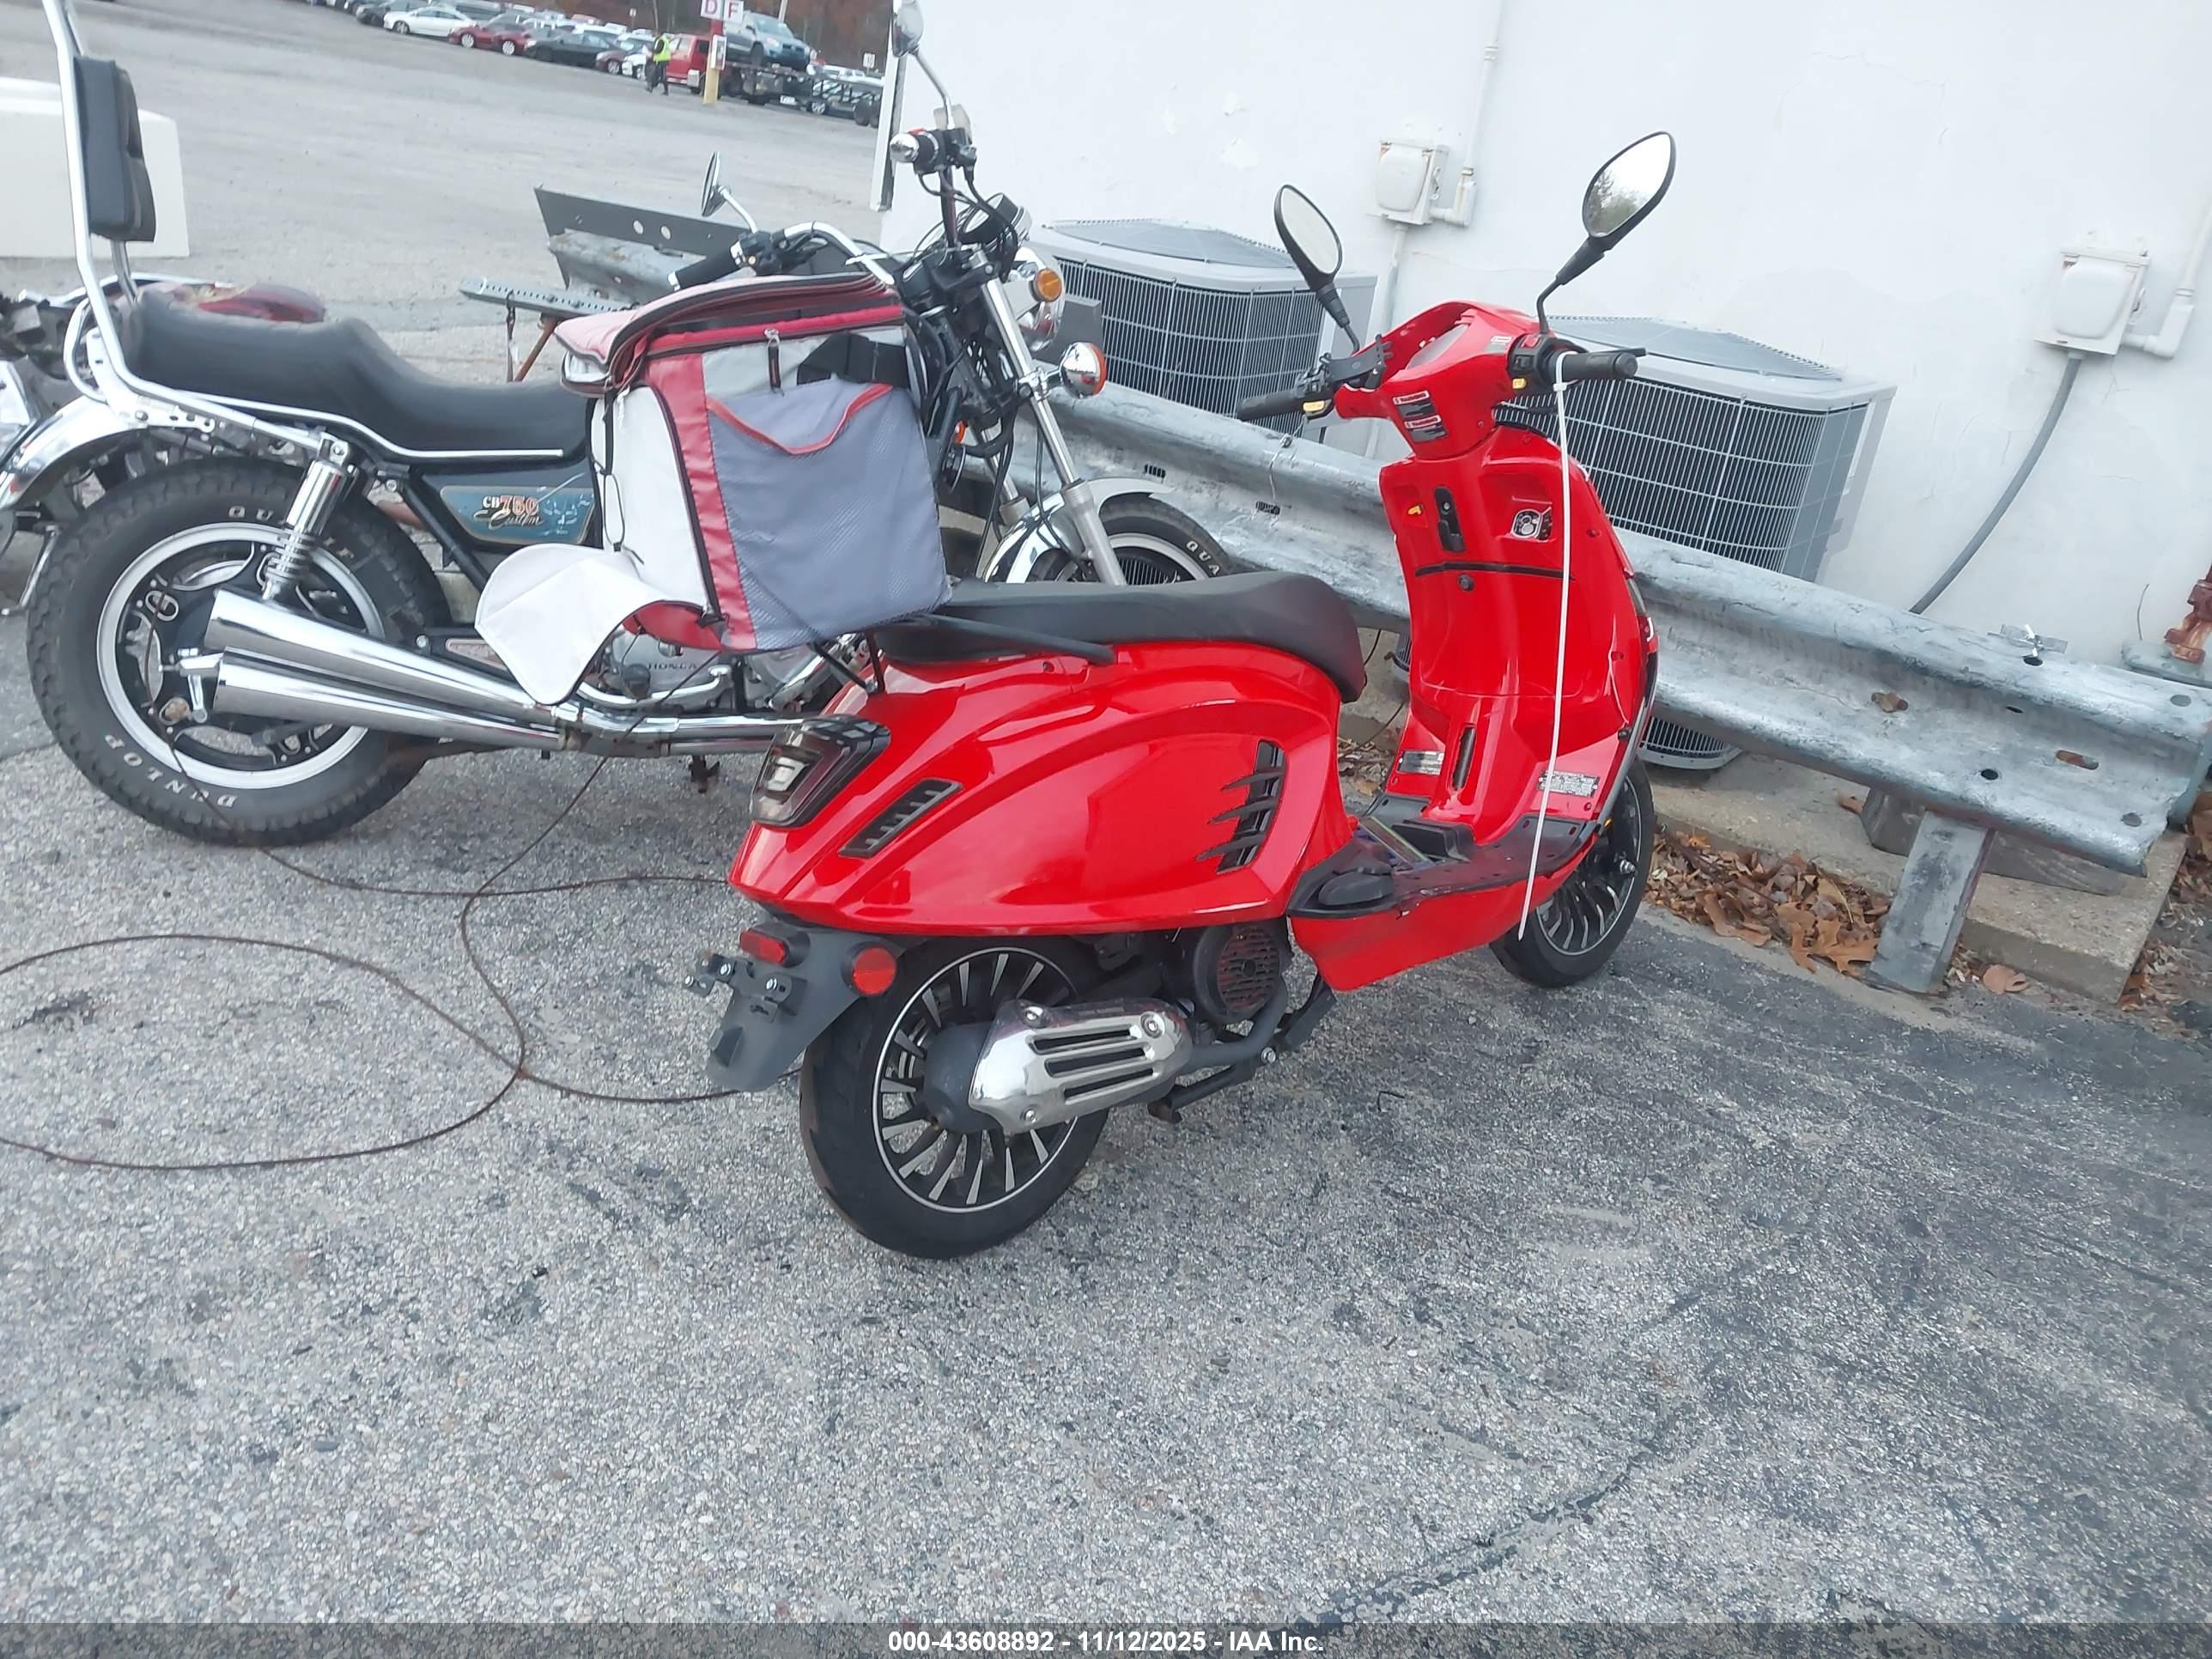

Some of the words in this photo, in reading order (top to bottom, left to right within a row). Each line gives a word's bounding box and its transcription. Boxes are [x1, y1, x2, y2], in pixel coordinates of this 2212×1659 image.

[704, 0, 718, 15] D
[728, 3, 739, 18] F
[104, 734, 238, 808] DUNLOP
